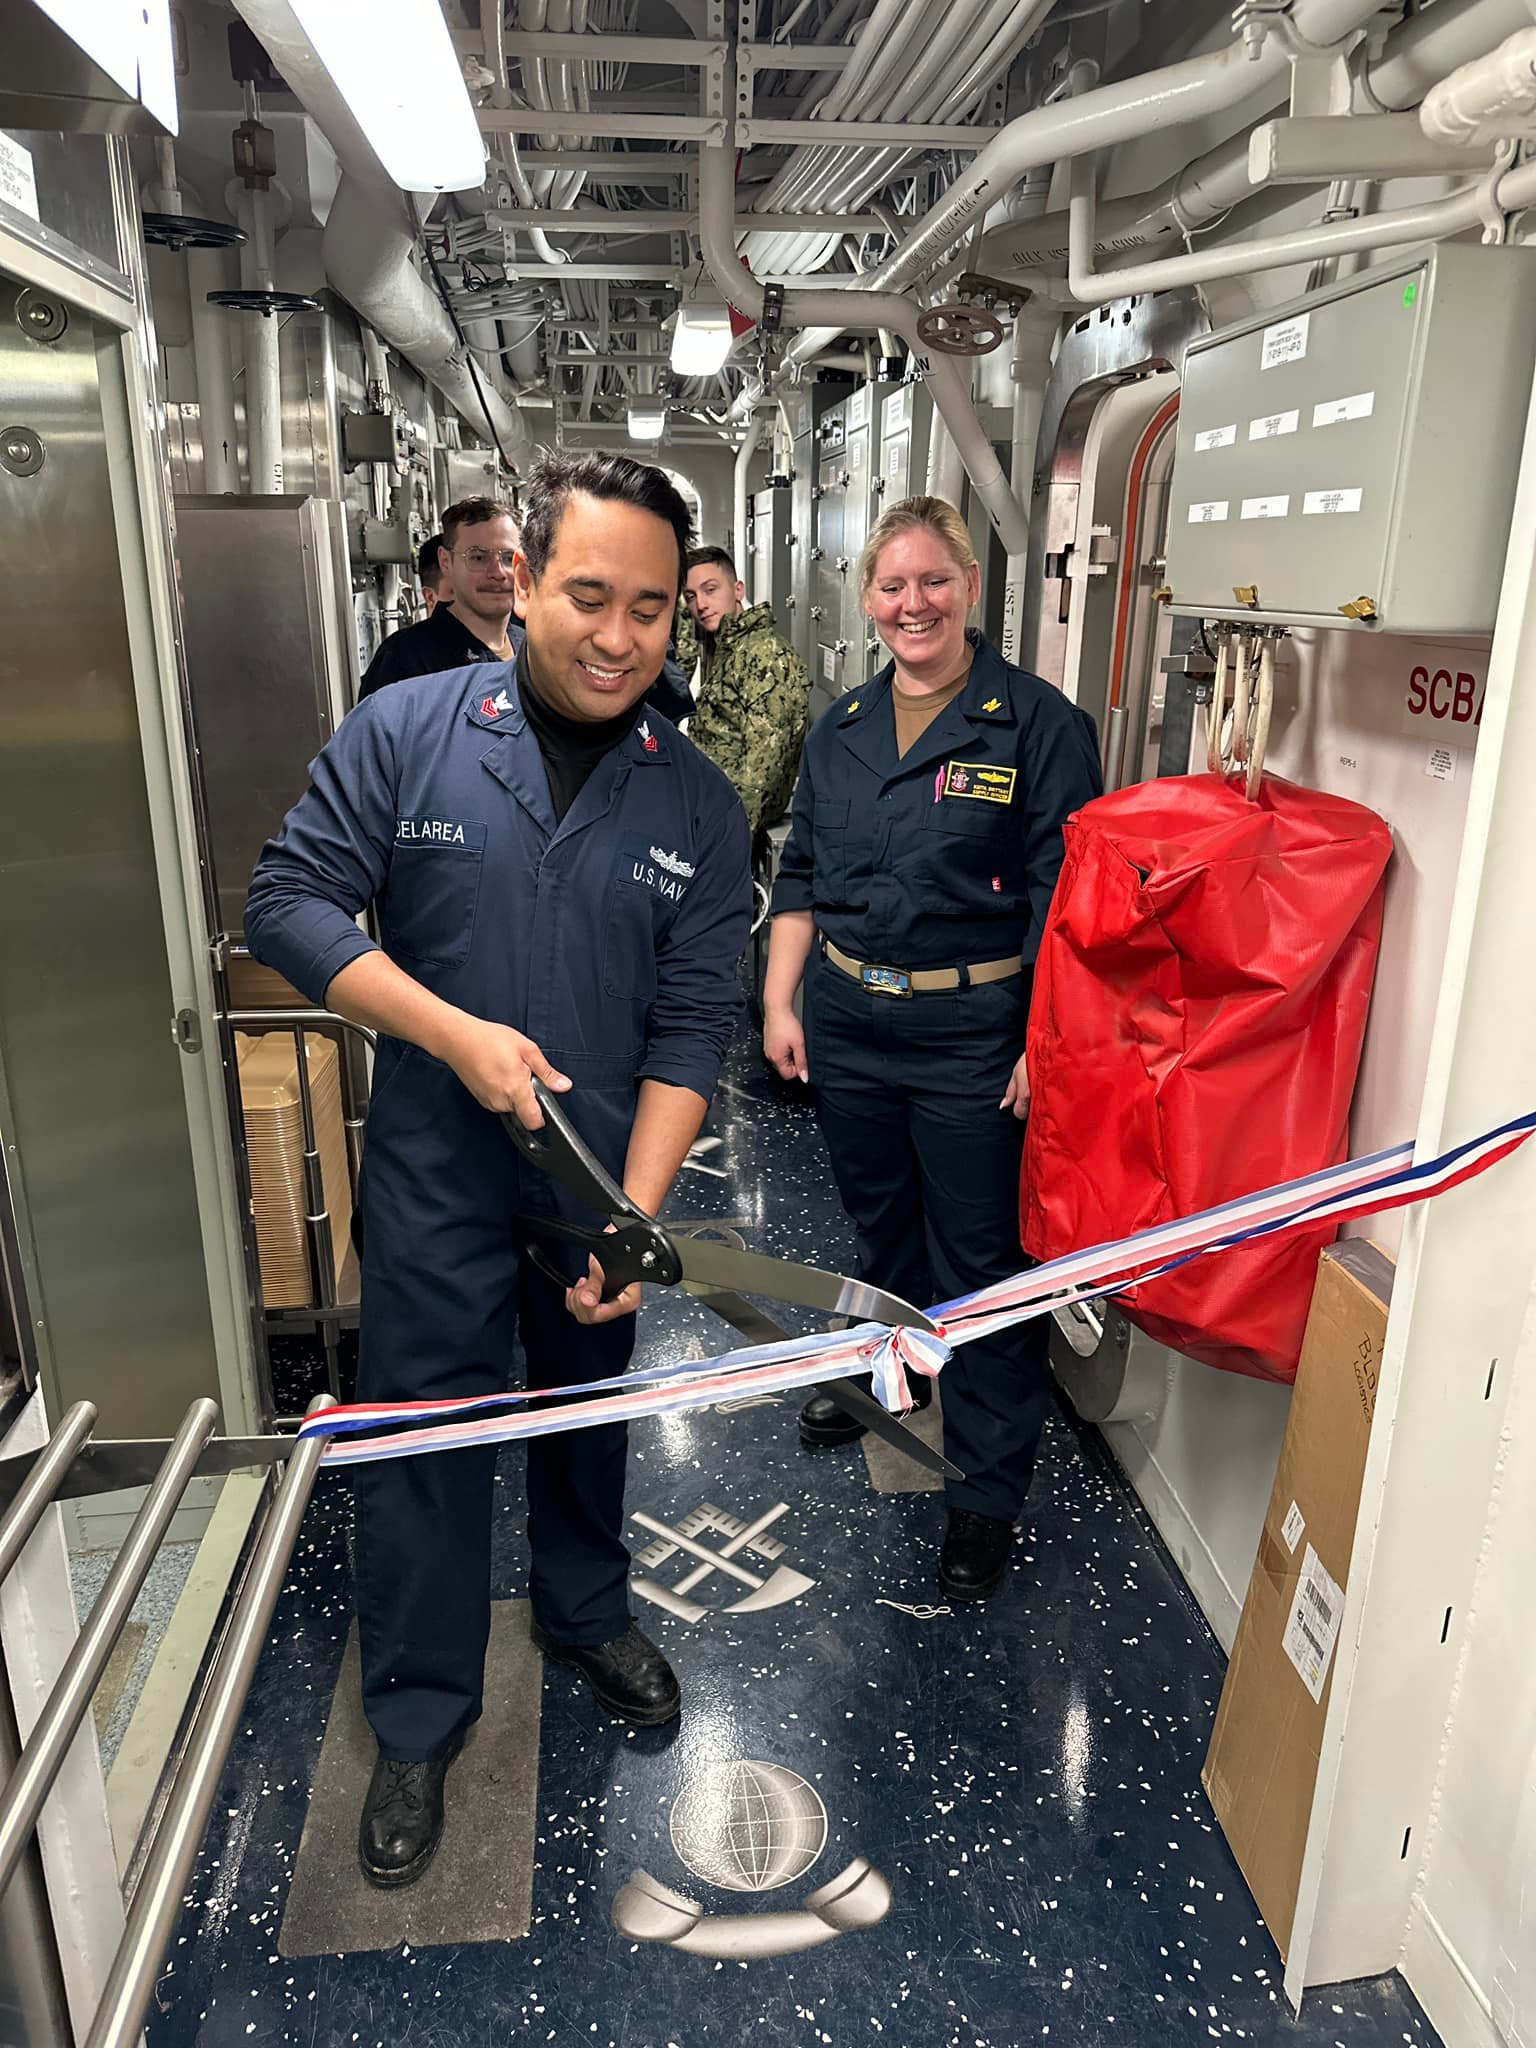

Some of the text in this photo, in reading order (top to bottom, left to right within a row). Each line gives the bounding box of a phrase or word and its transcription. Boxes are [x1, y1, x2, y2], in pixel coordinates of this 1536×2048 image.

[1408, 666, 1487, 726] SCB
[633, 862, 688, 902] U.S. NAV
